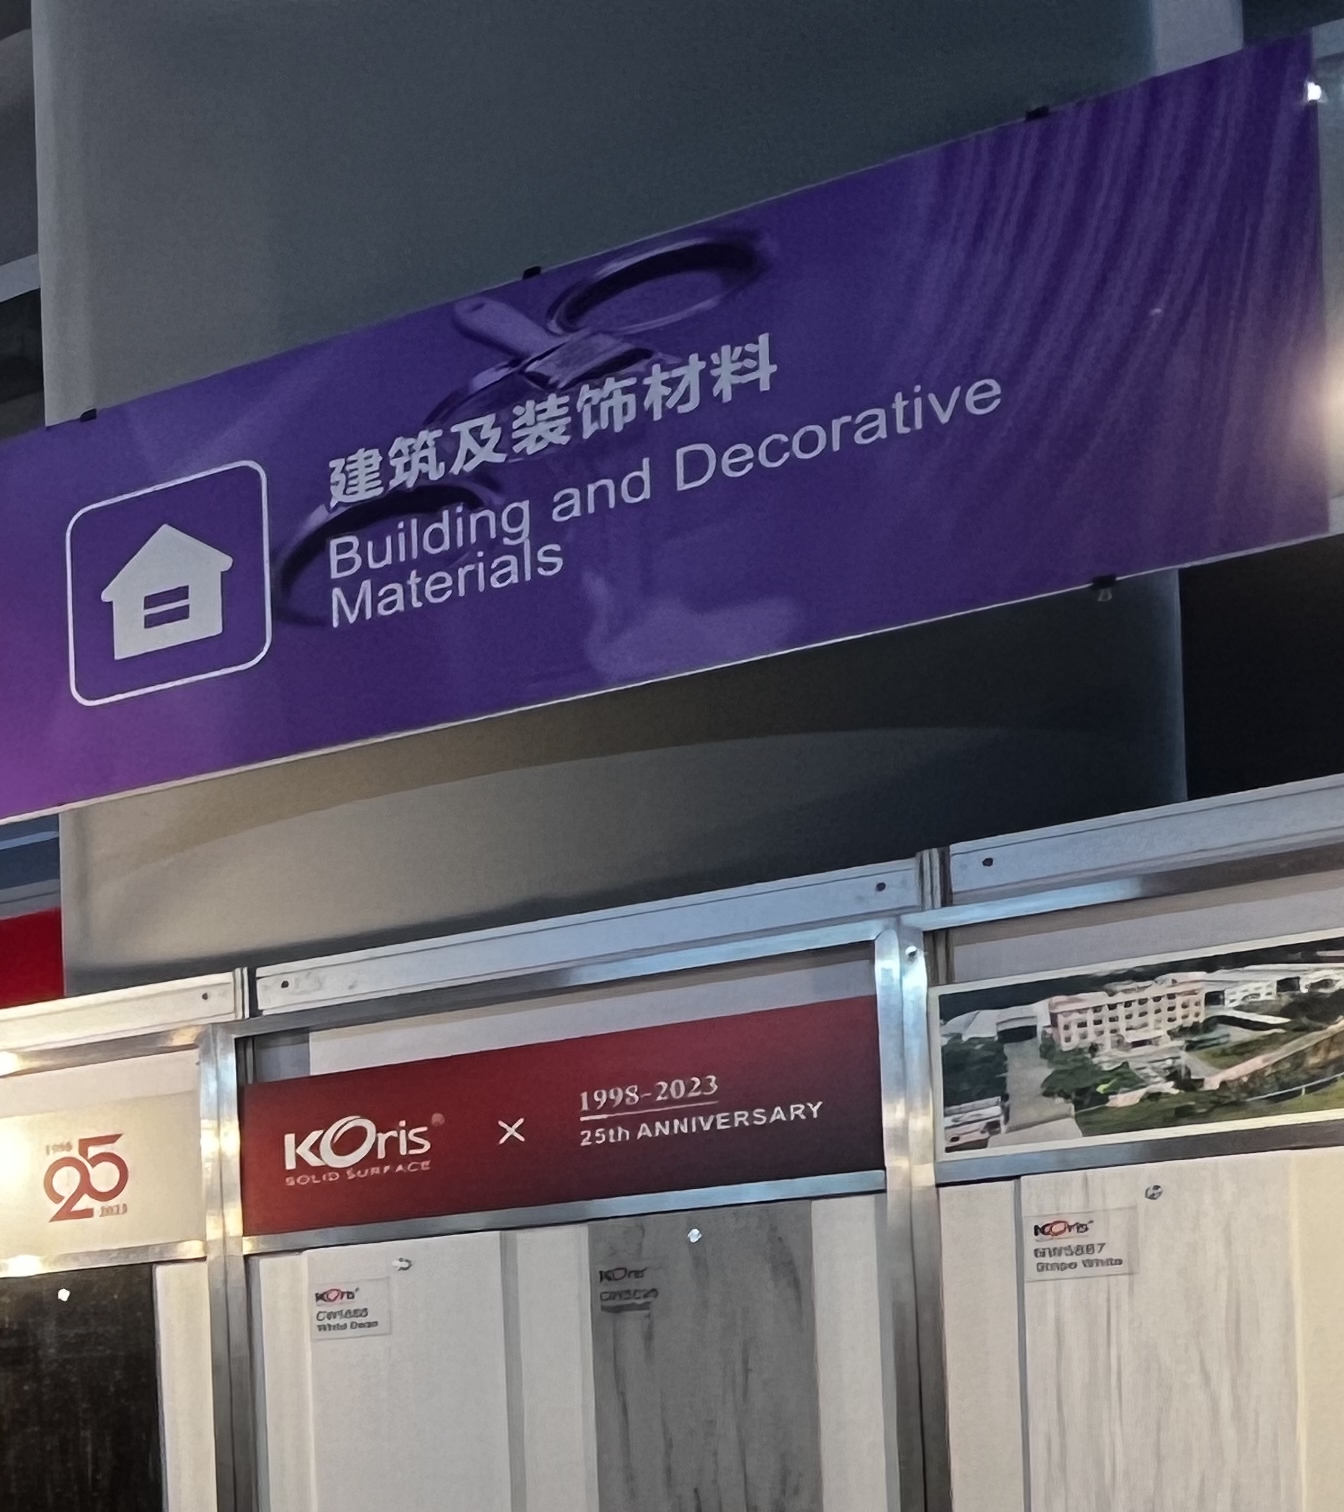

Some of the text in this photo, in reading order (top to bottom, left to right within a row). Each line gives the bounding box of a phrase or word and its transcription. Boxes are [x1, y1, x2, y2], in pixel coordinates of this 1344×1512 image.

[328, 333, 777, 507] 建筑及装饰材料
[329, 378, 1002, 579] Building and Decorative
[330, 539, 564, 629] Materials
[579, 1075, 718, 1112] 1998-2023
[580, 1101, 823, 1147] 25th ANNIVERSARY
[43, 1133, 129, 1222] 25
[285, 1160, 431, 1186] SOLID SURFACE
